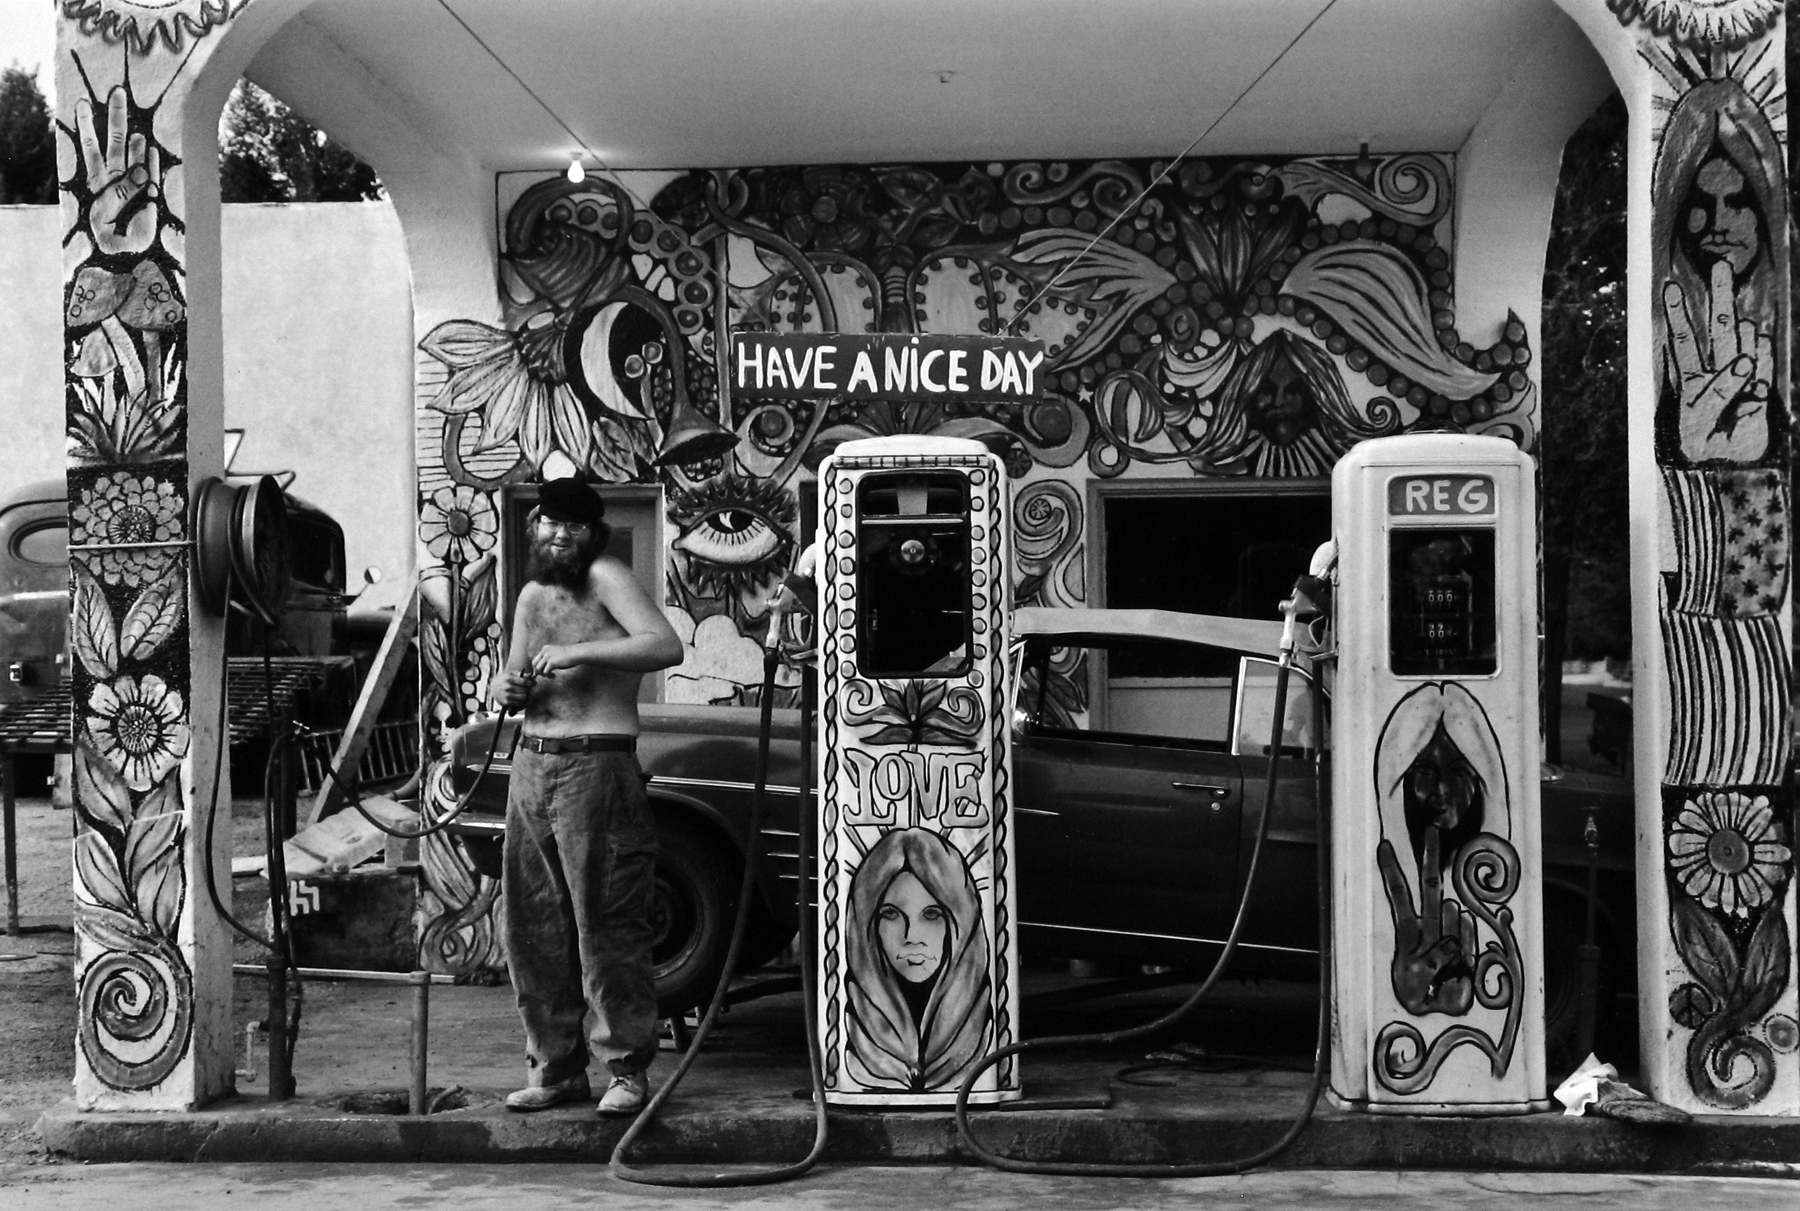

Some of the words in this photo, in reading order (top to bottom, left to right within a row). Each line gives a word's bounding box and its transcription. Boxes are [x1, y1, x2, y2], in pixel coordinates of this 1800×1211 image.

[737, 342, 838, 390] HAVE
[847, 351, 878, 393] A
[980, 349, 1044, 395] DAY
[1405, 480, 1489, 513] REG
[843, 748, 990, 827] LOVE
